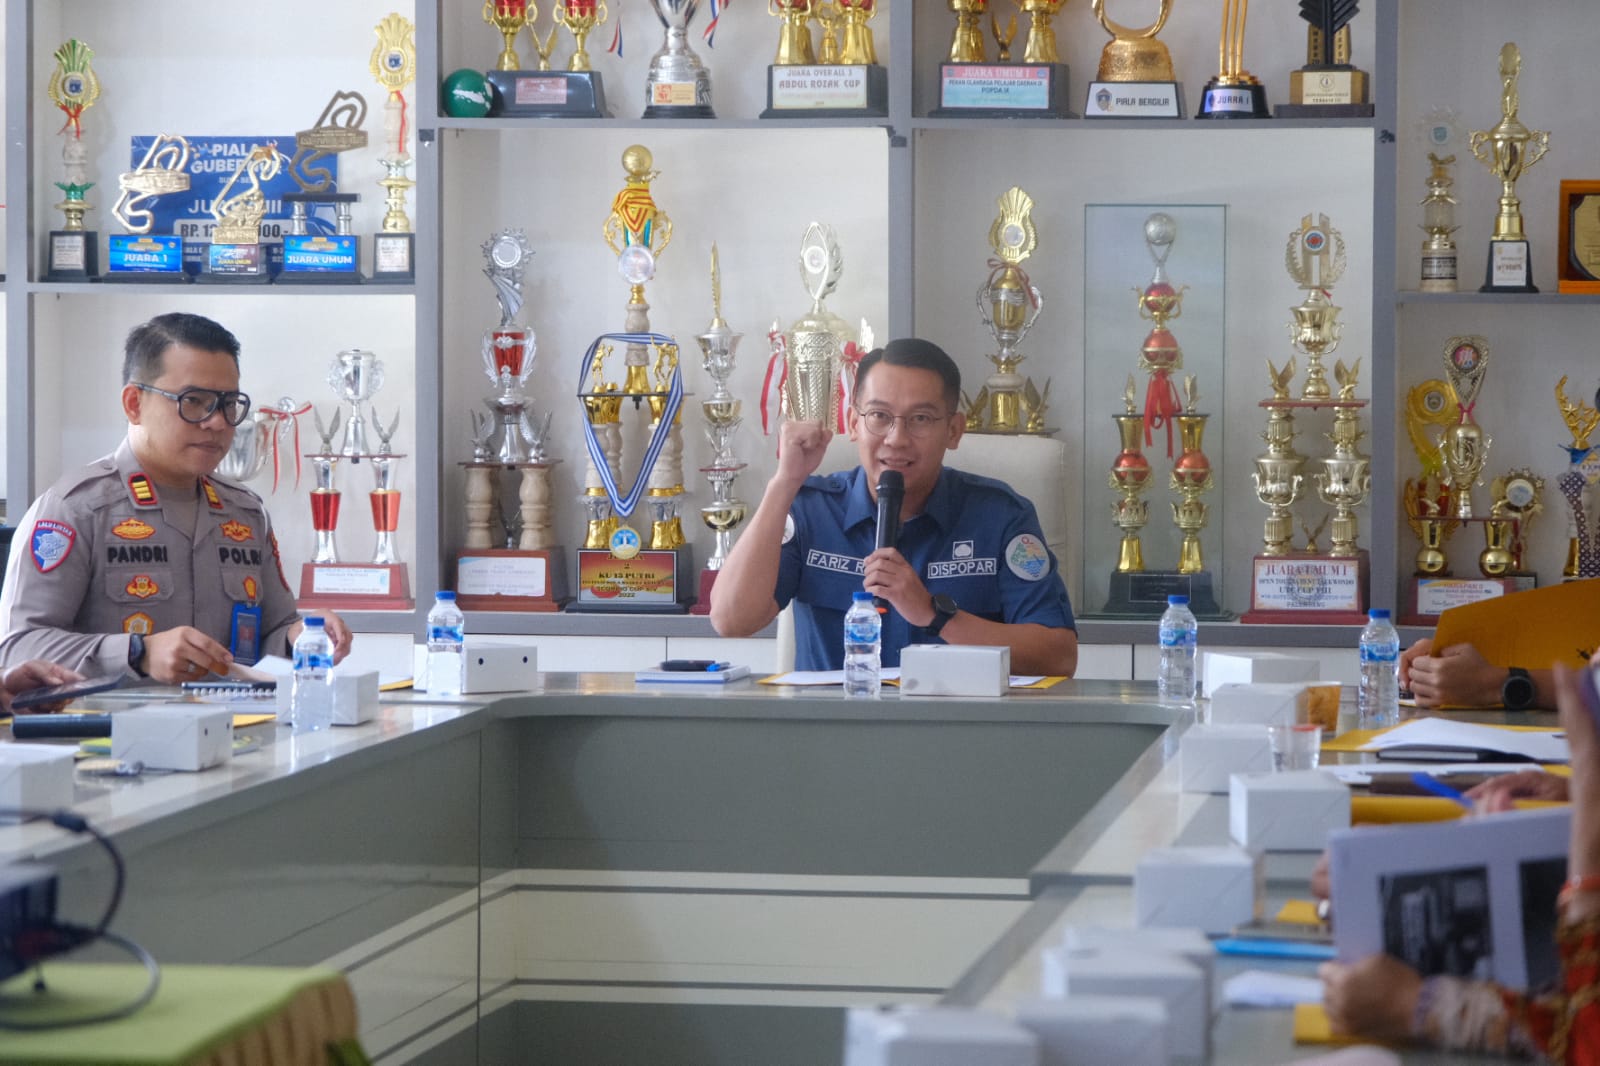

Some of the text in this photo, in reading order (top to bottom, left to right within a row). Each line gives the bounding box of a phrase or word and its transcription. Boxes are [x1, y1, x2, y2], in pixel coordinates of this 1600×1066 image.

[779, 80, 808, 88] ABDUL
[843, 80, 861, 88] CUP
[1115, 97, 1137, 106] PIALA
[1216, 96, 1244, 105] JUARA
[124, 253, 159, 263] JUARA
[287, 255, 353, 264] JUARA UMUM
[107, 545, 168, 563] PANDRI
[218, 547, 262, 565] POLRI
[809, 553, 849, 570] FARIZ
[930, 561, 994, 576] DISPOPAR
